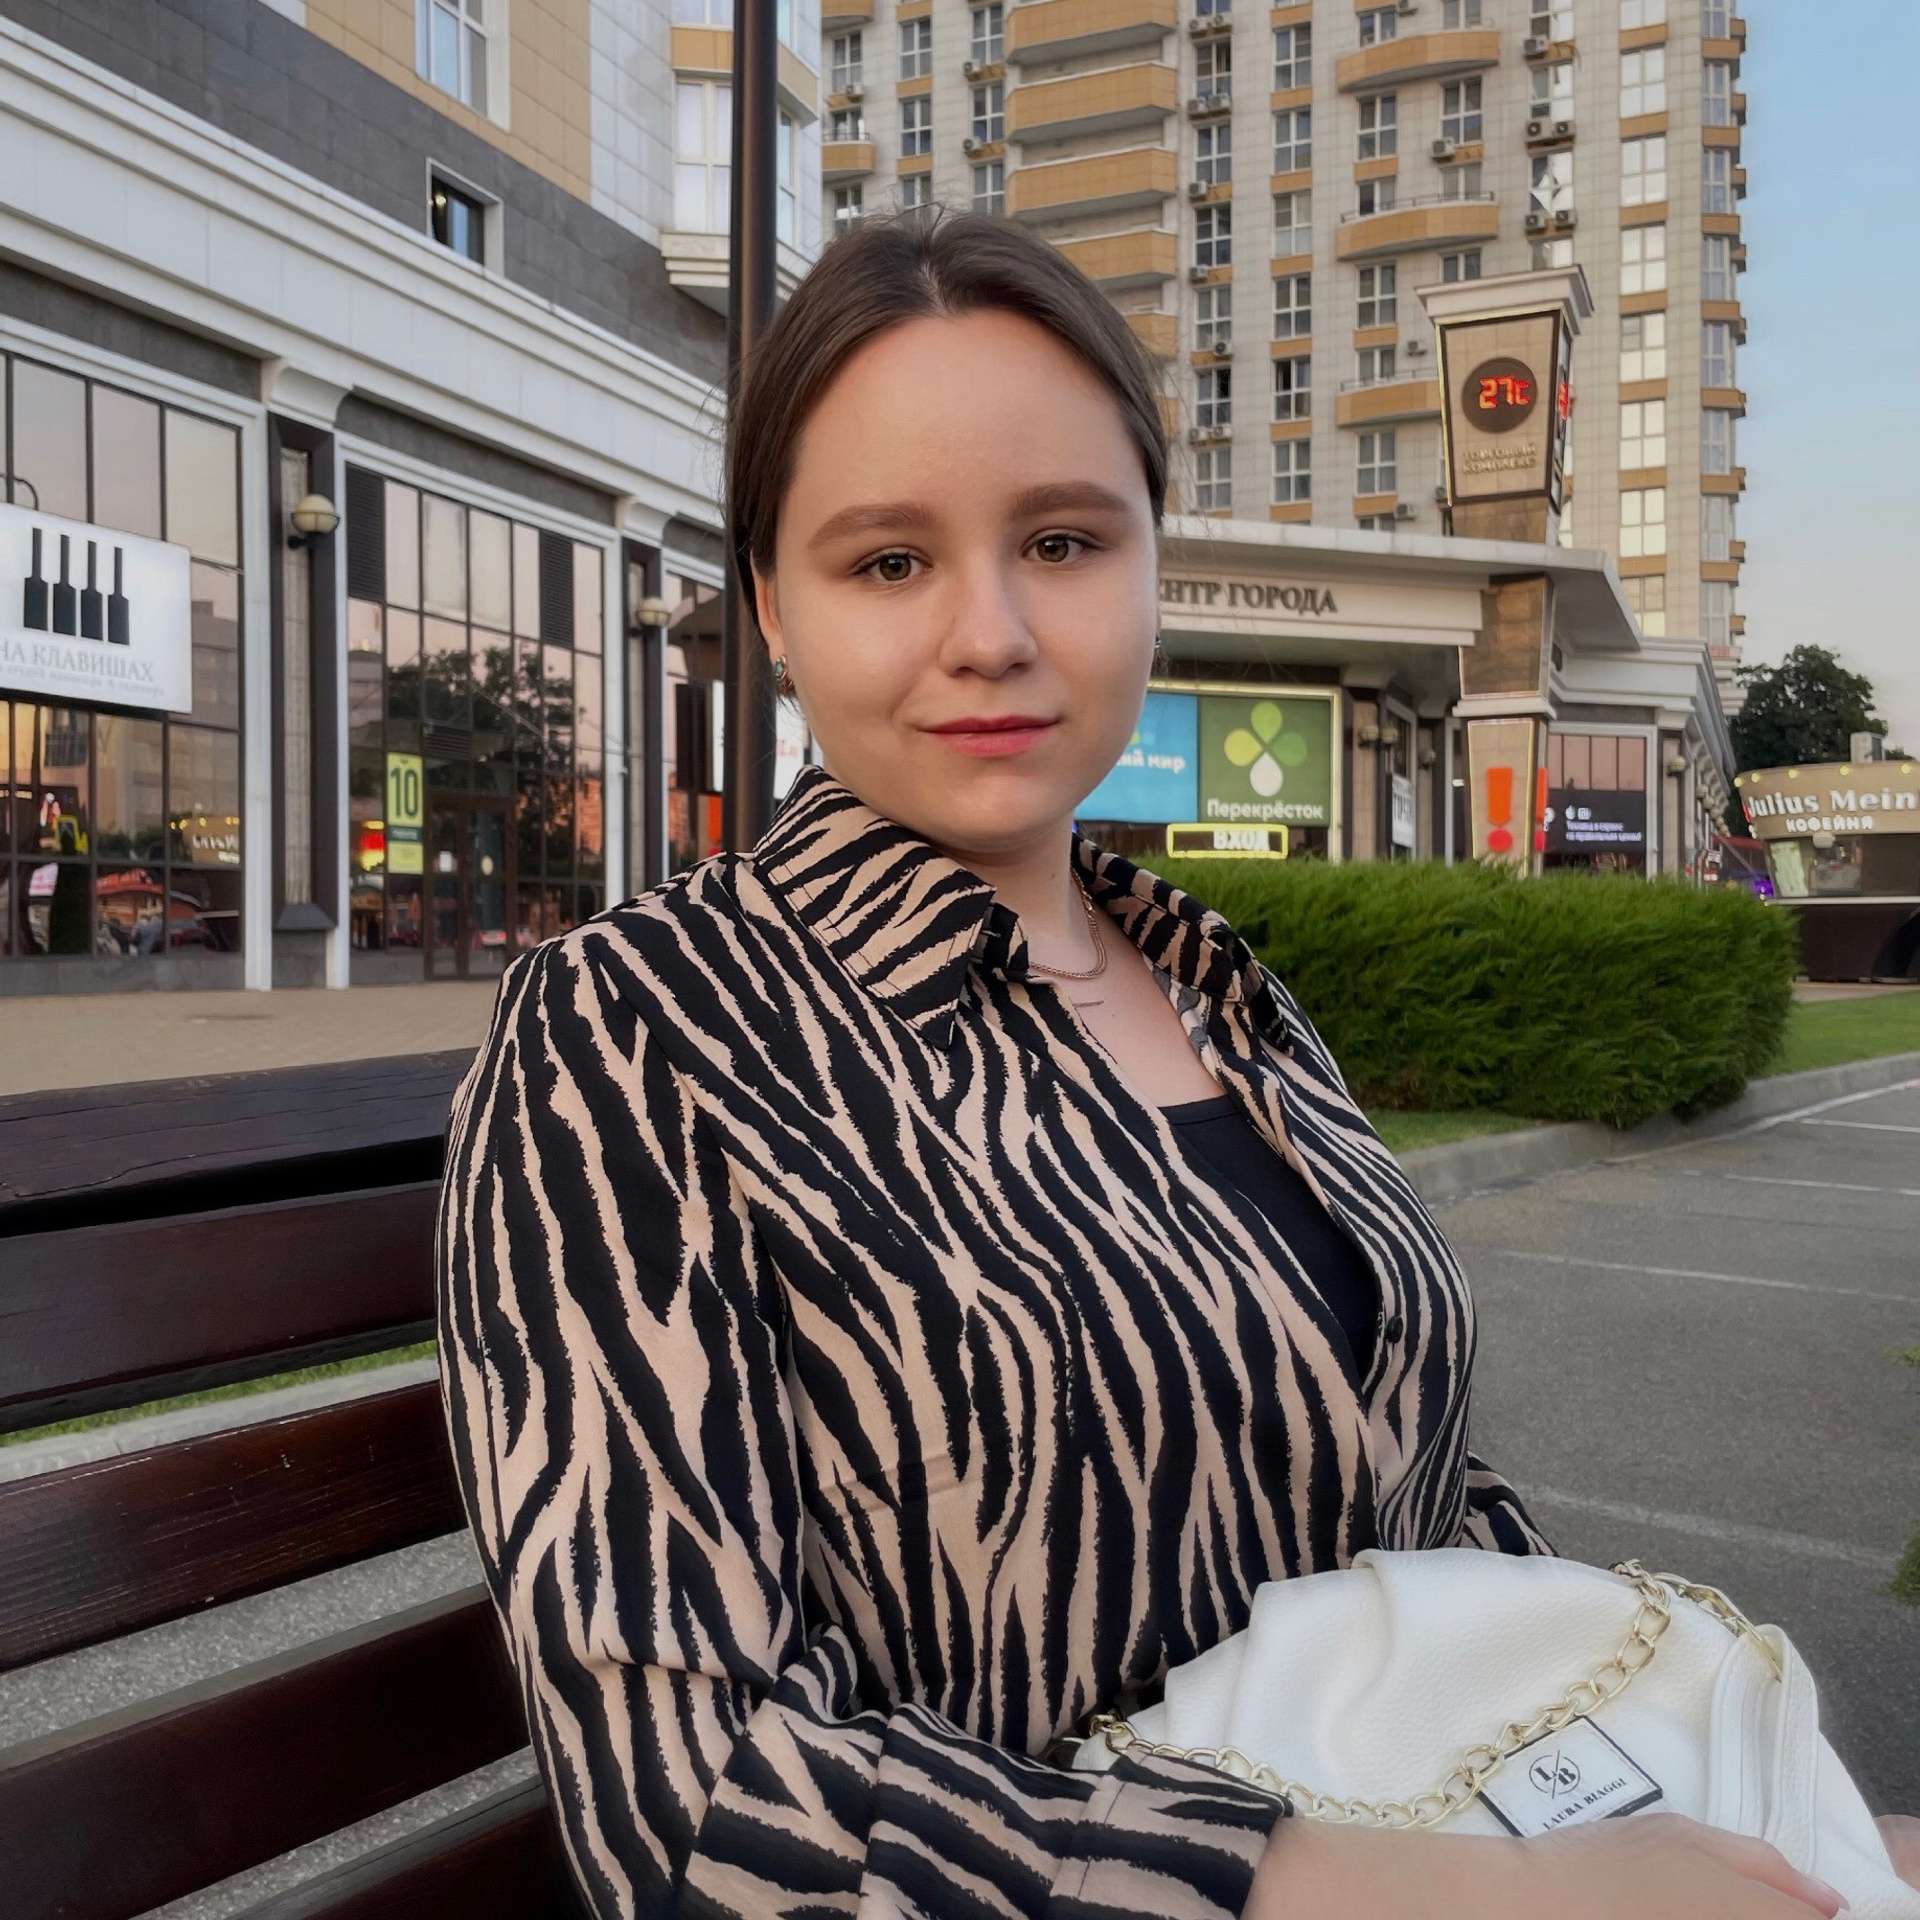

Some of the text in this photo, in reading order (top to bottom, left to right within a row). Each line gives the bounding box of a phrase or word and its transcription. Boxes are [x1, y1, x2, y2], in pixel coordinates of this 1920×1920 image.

[1160, 578, 1338, 615] НТР ГОРОДА
[32, 641, 155, 683] КЛАВИШАХ
[1147, 753, 1187, 774] мир
[390, 767, 418, 819] 10
[1748, 791, 1820, 818] Julius
[1207, 799, 1325, 822] Перекрёсток
[1786, 815, 1874, 832] КОФЕЙНЯ
[1213, 830, 1270, 851] ВХОД
[1542, 1777, 1628, 1830] LAURA BIAGGI
